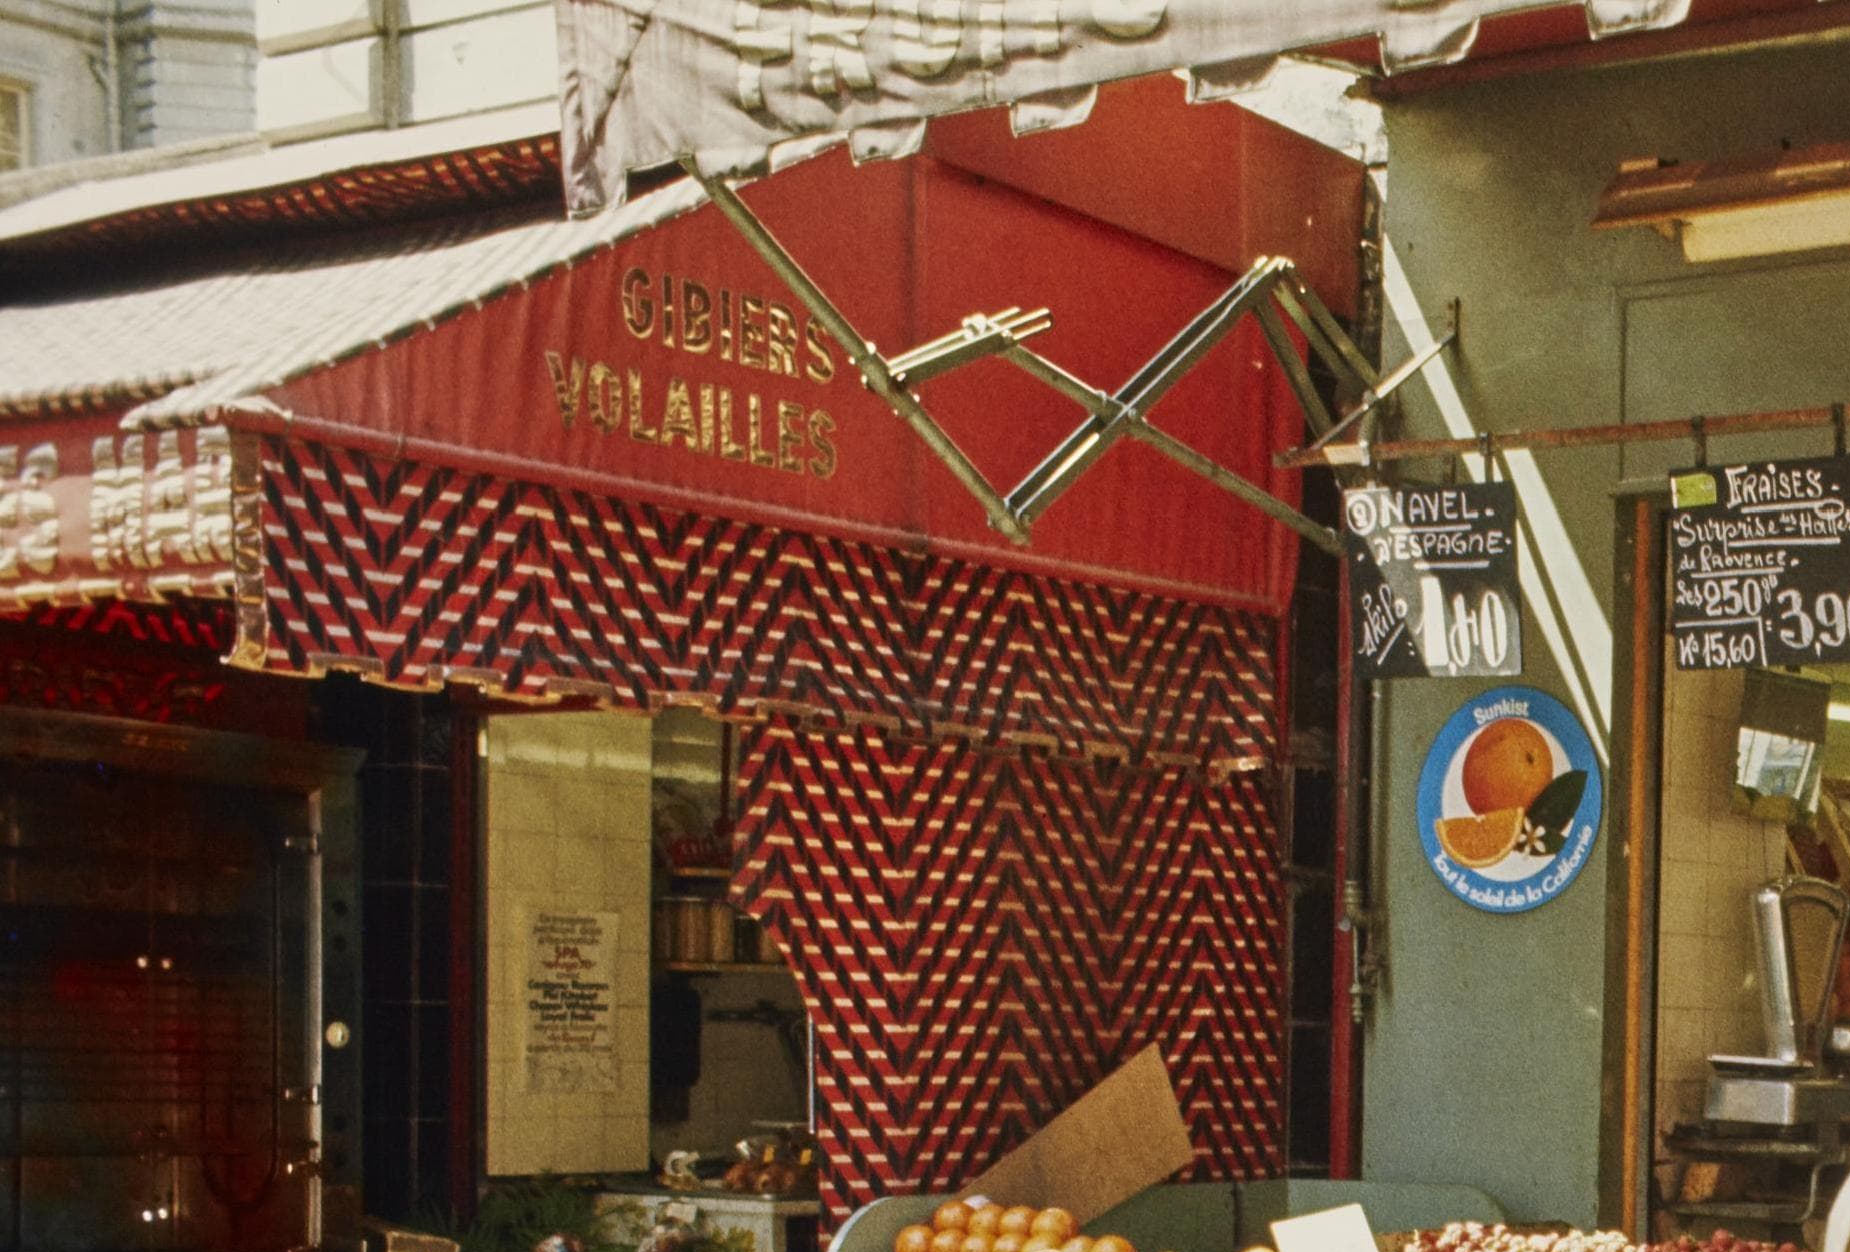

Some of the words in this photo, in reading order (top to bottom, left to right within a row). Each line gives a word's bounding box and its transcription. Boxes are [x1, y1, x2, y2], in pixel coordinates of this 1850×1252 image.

[622, 266, 835, 385] GIBIERS
[545, 350, 837, 480] VOLAILLES
[1703, 578, 1762, 616] 250
[1473, 697, 1530, 726] Sunkist
